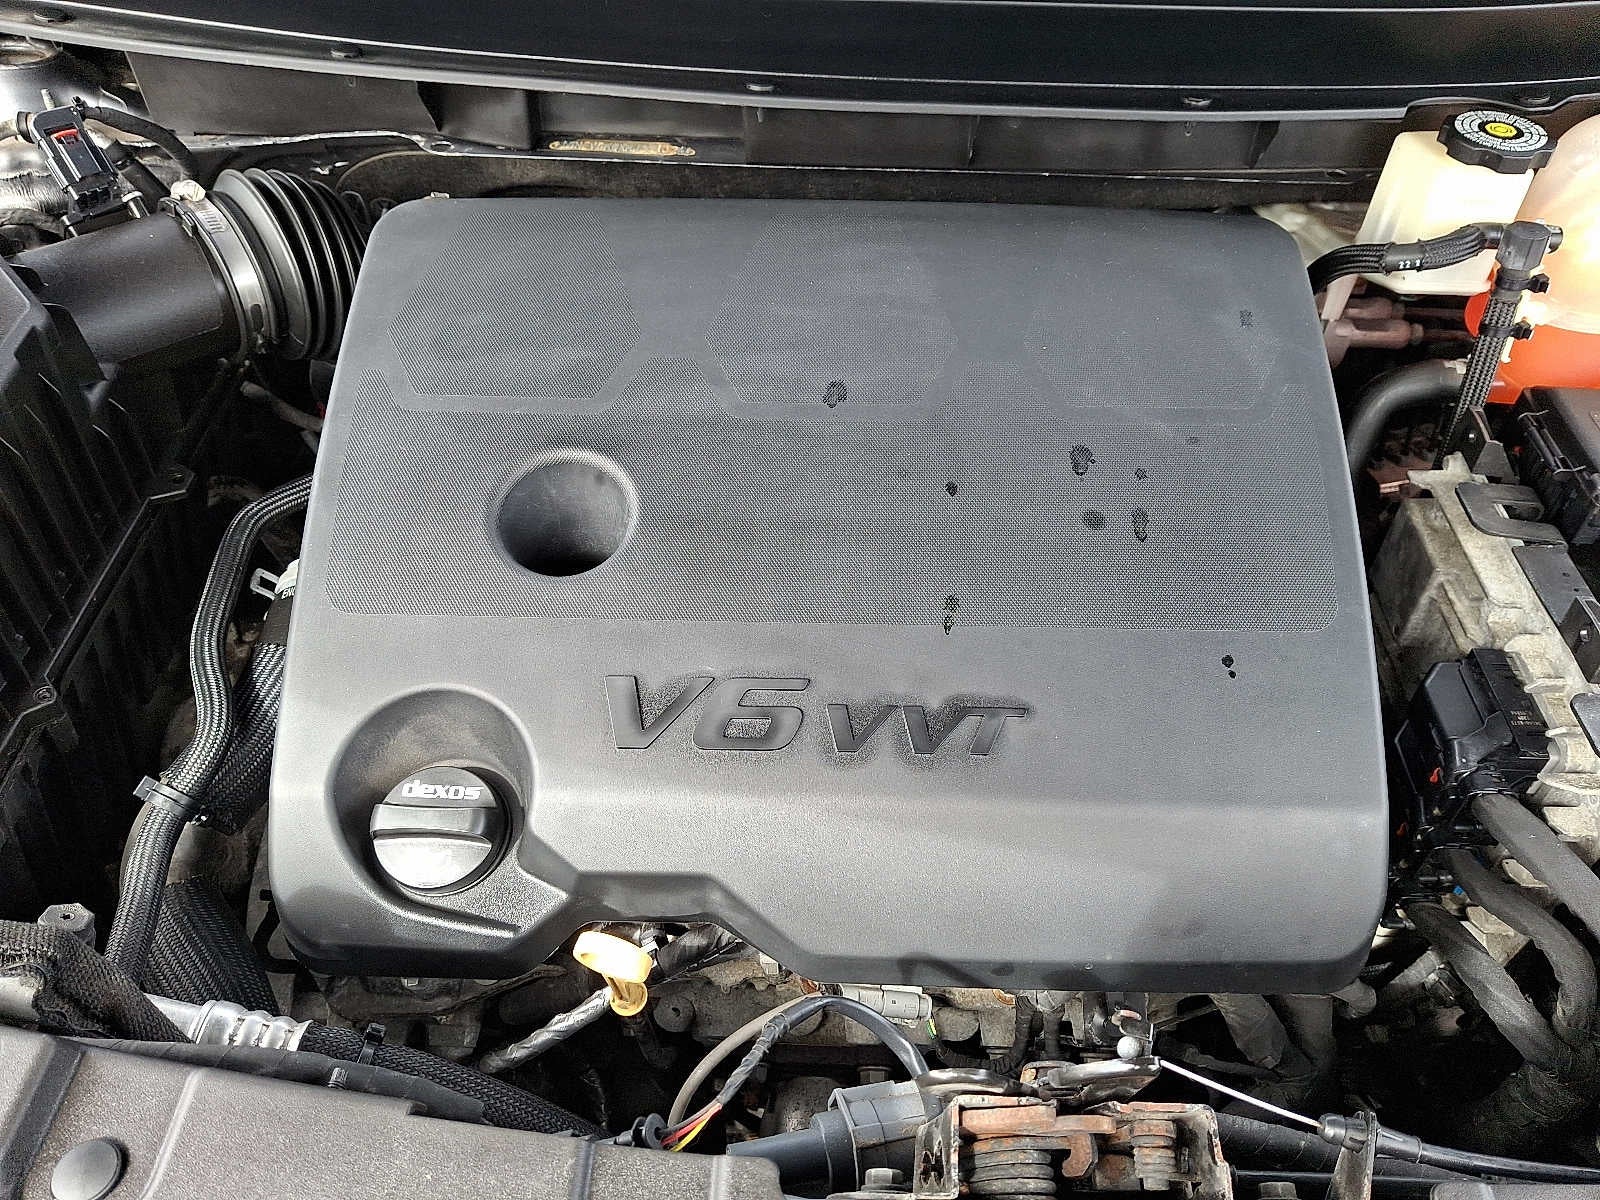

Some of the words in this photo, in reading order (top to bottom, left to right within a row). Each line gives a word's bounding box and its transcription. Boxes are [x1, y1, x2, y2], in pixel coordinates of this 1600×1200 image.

[604, 674, 811, 752] V6
[826, 703, 1029, 756] VVT
[401, 779, 485, 801] dexos
